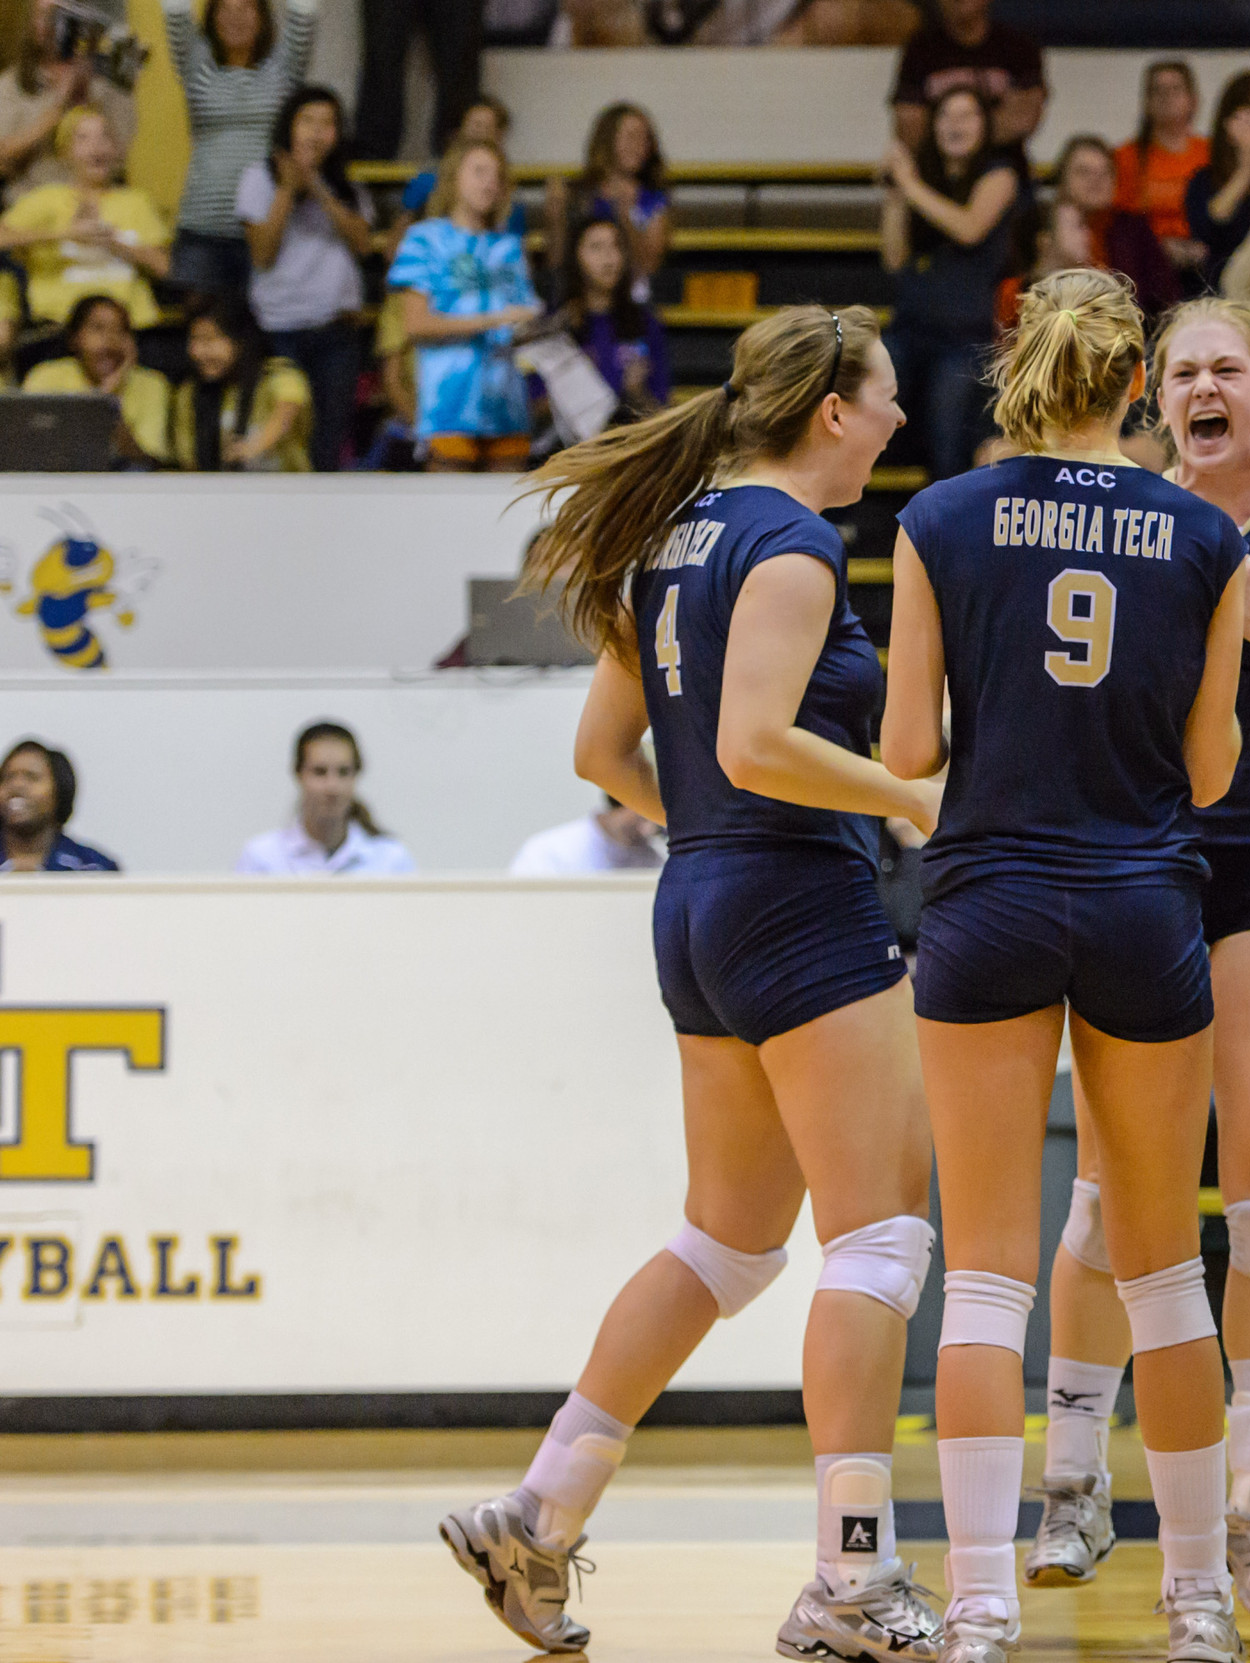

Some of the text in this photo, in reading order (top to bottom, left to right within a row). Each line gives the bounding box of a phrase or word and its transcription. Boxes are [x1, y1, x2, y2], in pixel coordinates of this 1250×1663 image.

[1055, 467, 1117, 489] ACC
[993, 497, 1175, 561] GEORGIA TECH
[655, 583, 683, 697] 4
[1044, 568, 1117, 688] 9
